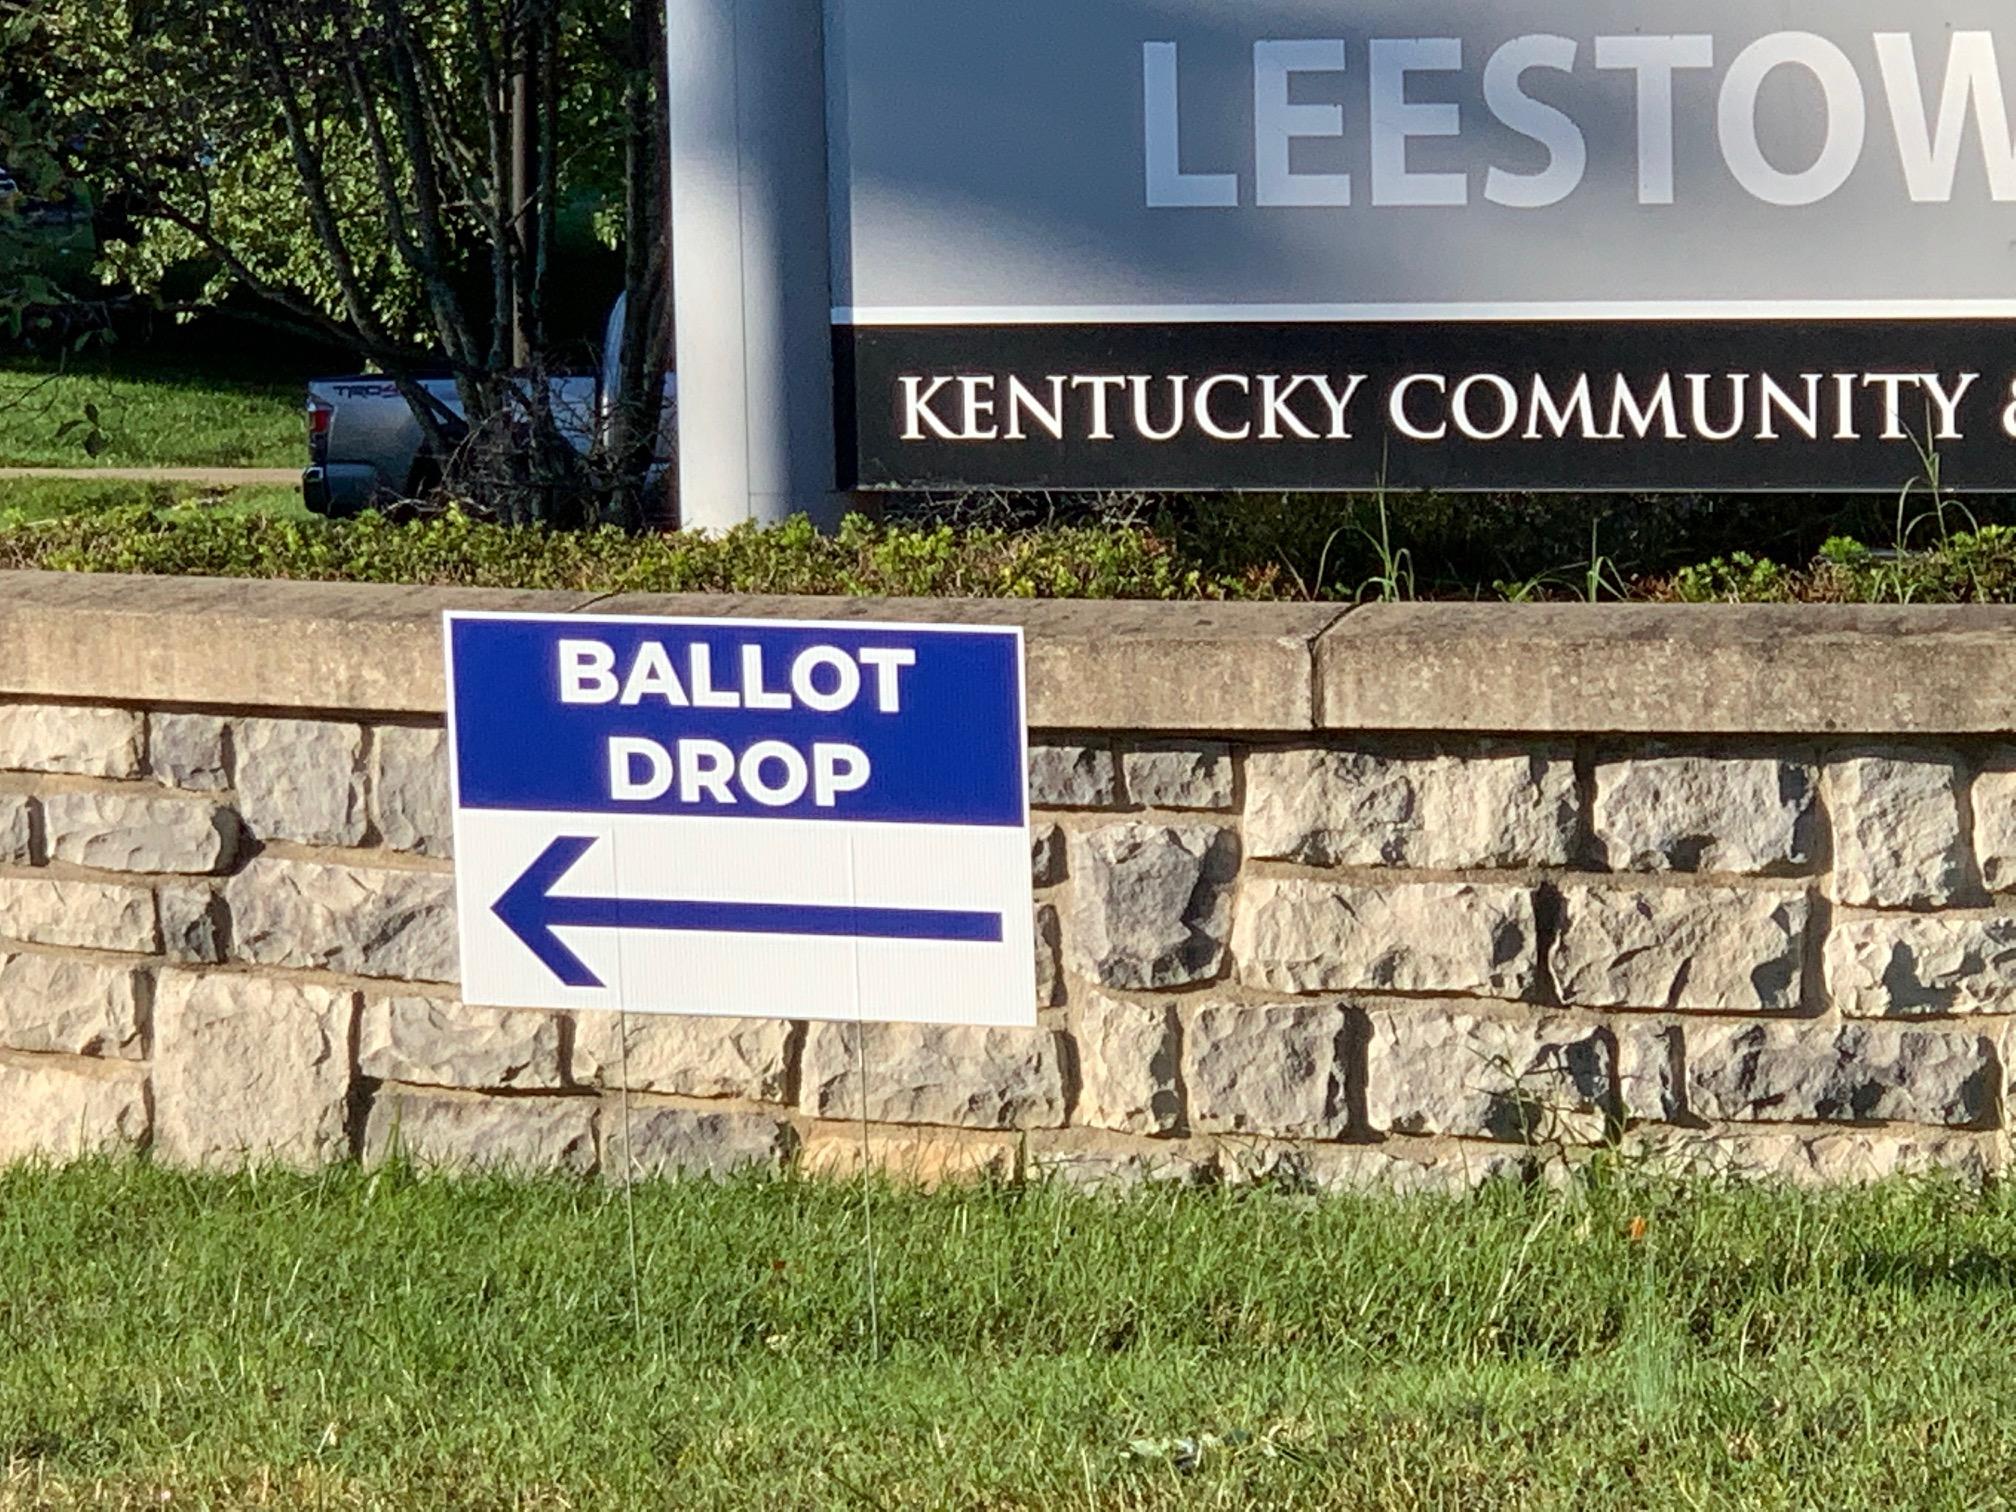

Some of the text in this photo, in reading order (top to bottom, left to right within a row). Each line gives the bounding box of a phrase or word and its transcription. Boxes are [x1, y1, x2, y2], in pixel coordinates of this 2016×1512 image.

[1143, 30, 2016, 208] LEESTOW
[899, 373, 1367, 441] KENTUCKY
[1389, 372, 1980, 440] COMMUNITY
[558, 638, 916, 713] BALLOT
[607, 736, 872, 807] DROP
